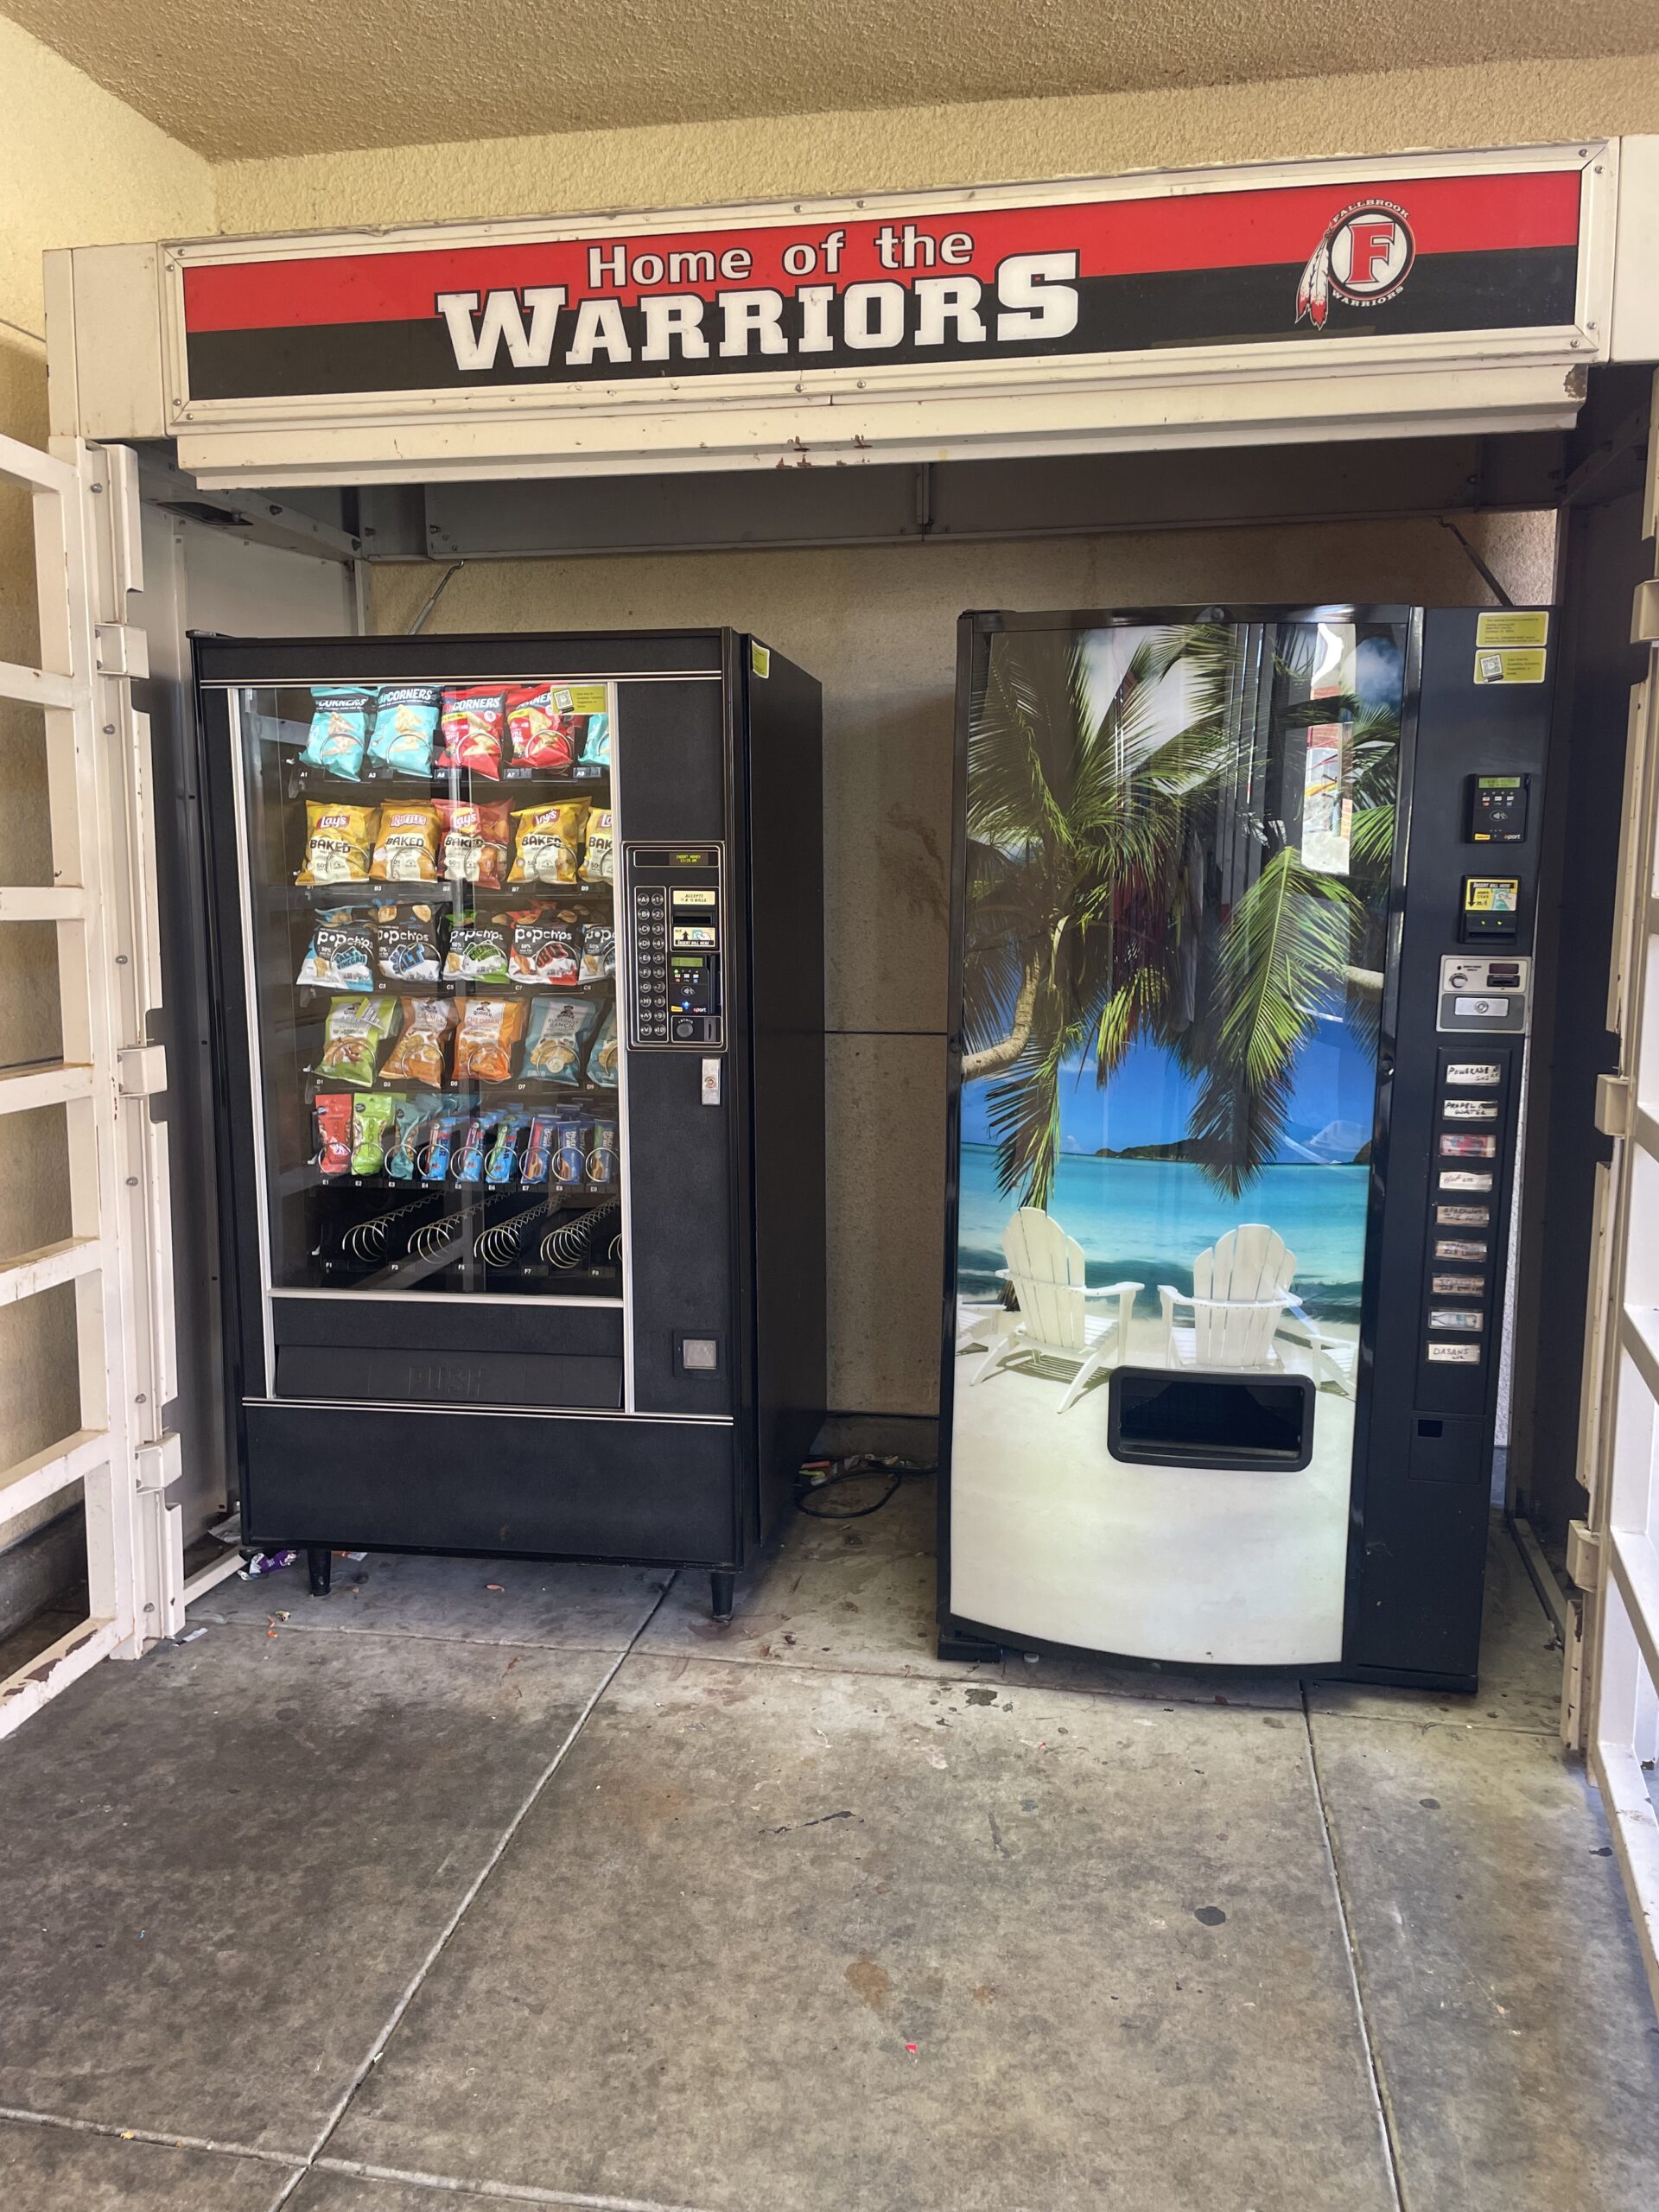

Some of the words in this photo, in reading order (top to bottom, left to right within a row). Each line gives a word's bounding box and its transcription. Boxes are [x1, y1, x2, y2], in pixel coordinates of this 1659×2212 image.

[1332, 200, 1409, 223] FALLBROOK
[588, 246, 753, 289] Home
[784, 230, 845, 274] of
[874, 225, 974, 270] the
[1345, 221, 1395, 284] F
[1332, 287, 1403, 307] WARRIORS
[436, 251, 1079, 371] WARRIORS
[321, 815, 346, 828] Lay's
[452, 813, 477, 829] Lay's
[310, 839, 351, 854] BAKED
[386, 836, 424, 848] BAKED
[446, 836, 484, 848] BAKED
[521, 836, 563, 848] BAKED
[515, 929, 572, 943] popchips
